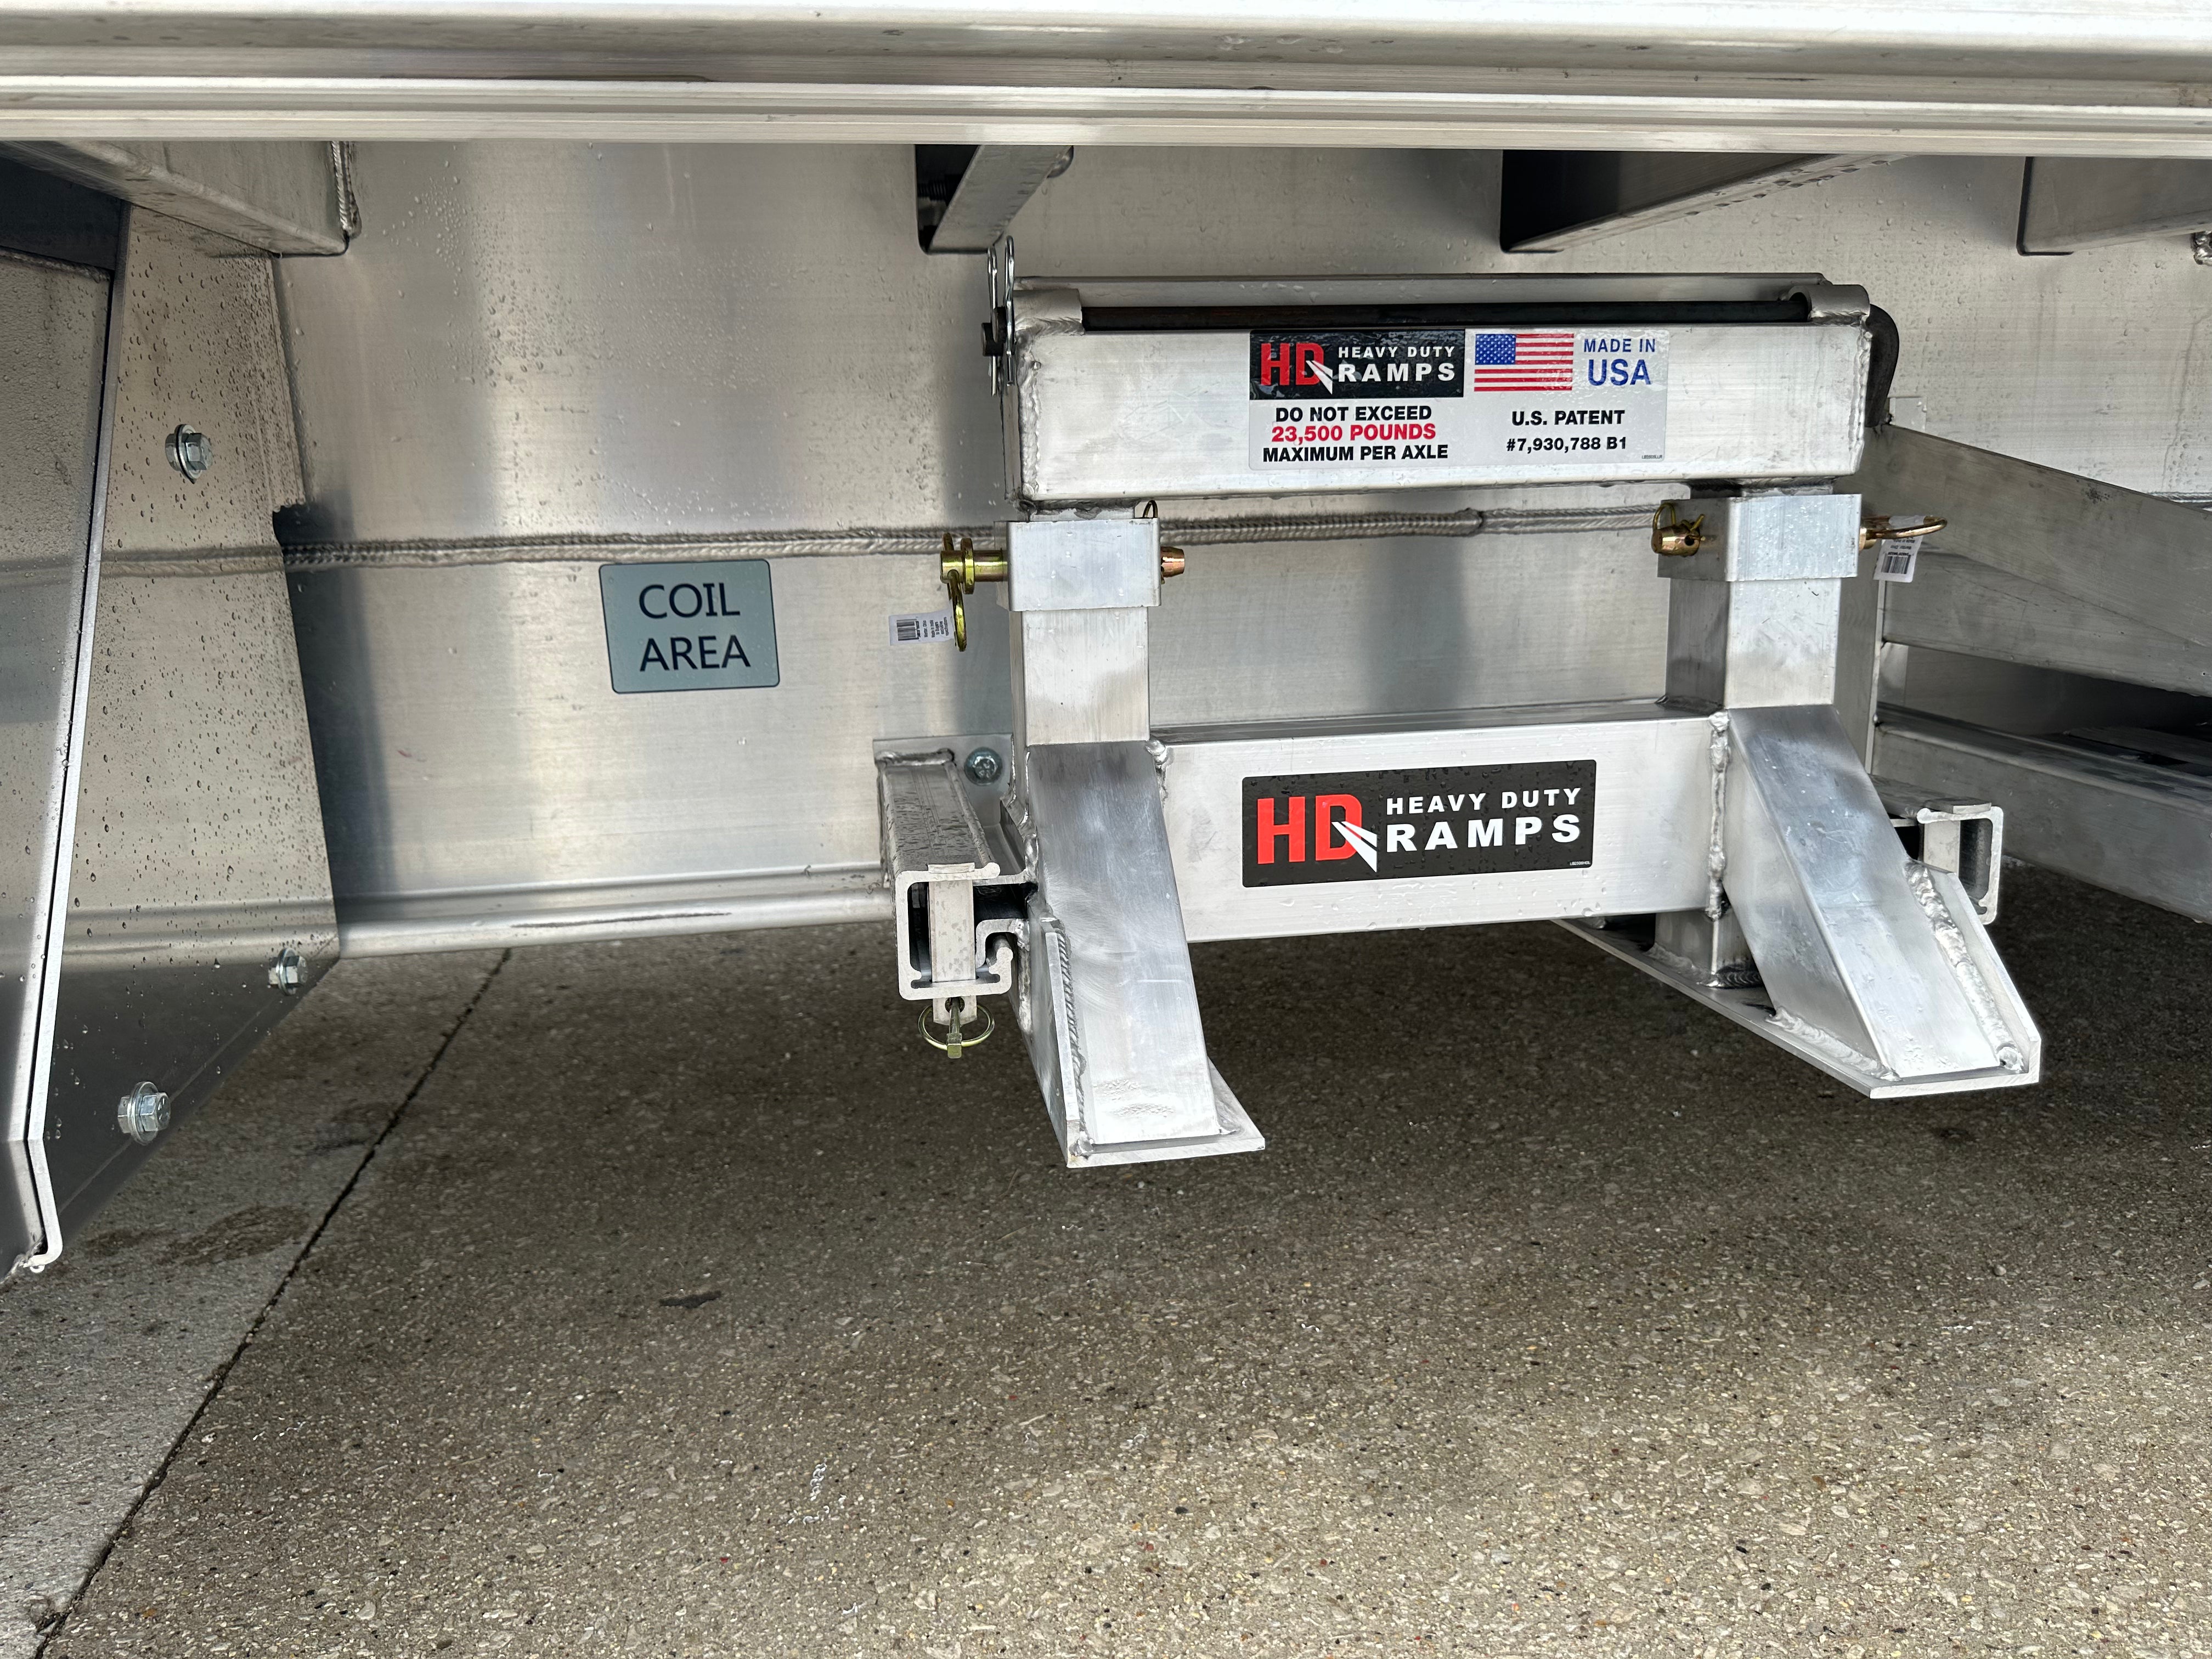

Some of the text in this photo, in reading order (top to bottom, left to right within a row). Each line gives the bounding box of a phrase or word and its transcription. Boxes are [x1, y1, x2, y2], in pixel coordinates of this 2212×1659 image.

[1339, 346, 1455, 358] HEAVY DUTY
[1584, 338, 1655, 353] MADE IN
[1261, 342, 1324, 386] HD
[1339, 363, 1455, 382] RAMPS
[1588, 359, 1651, 386] USA
[1276, 405, 1432, 422] DO NOT EXCEED
[1512, 410, 1625, 426] U.S. PATENT
[1272, 423, 1436, 445] 23,500 POUNDS
[1506, 436, 1626, 454] #7,930,788 B1
[1263, 444, 1448, 462] MAXIMUM PER AXLE
[639, 582, 741, 619] COIL
[639, 635, 751, 672] AREA
[1386, 787, 1581, 815] HEAVY DUTY
[1257, 794, 1362, 865] HD
[1386, 814, 1581, 853] RAMPS
